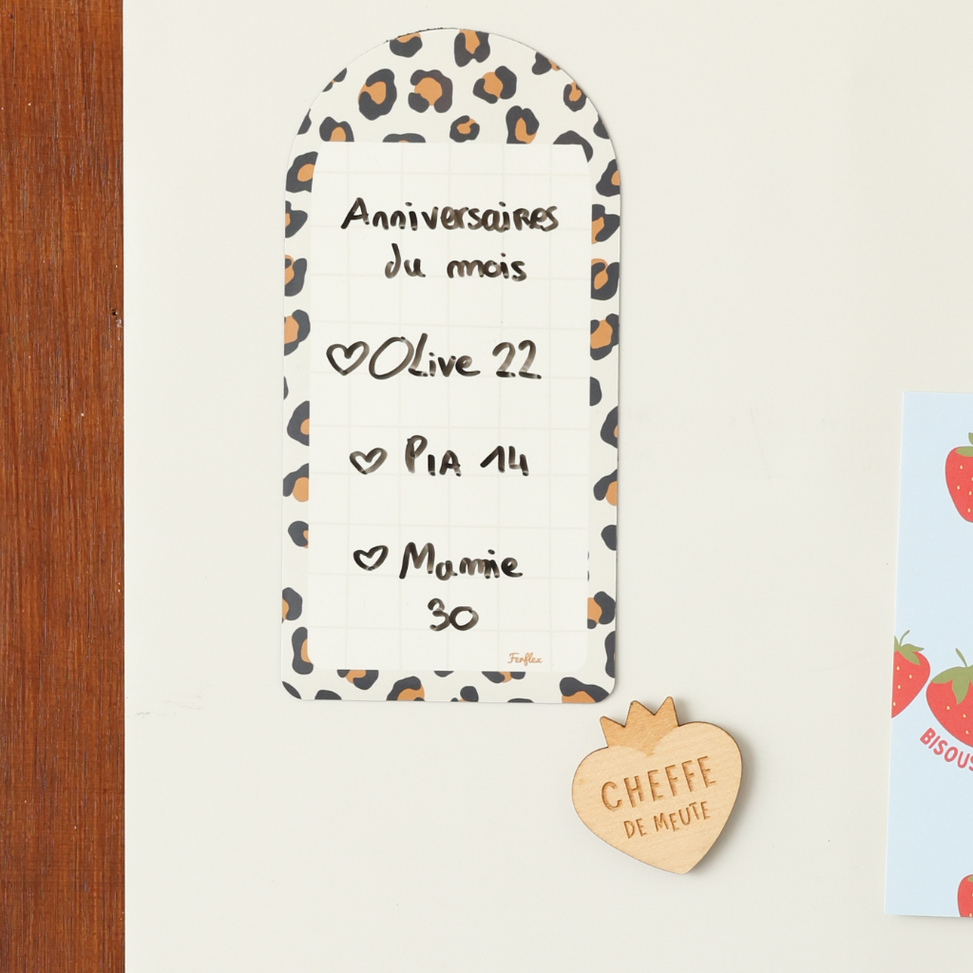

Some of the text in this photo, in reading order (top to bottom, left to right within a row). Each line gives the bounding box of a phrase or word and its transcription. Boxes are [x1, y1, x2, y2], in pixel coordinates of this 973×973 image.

[340, 197, 559, 233] Anniversaires
[384, 243, 527, 282] du mois
[492, 339, 542, 379] 22
[480, 445, 529, 477] 14
[427, 598, 479, 632] 30
[507, 651, 542, 667] Ferflex
[601, 755, 716, 812] CHEFFE
[623, 801, 711, 839] DE MEUTE
